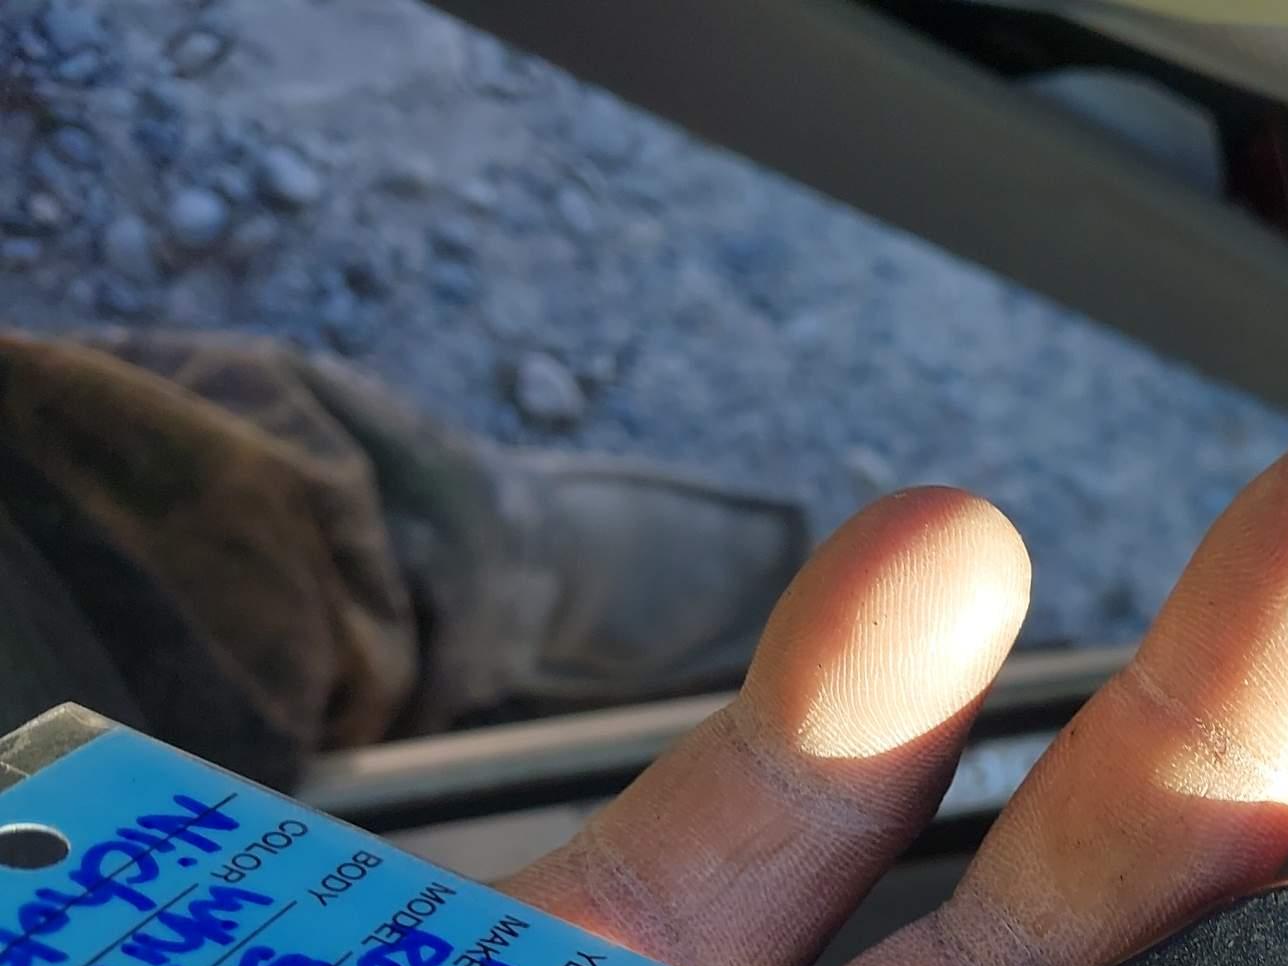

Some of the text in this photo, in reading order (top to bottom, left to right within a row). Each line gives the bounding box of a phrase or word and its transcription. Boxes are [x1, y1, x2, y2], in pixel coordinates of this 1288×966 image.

[210, 820, 308, 883] COLOR
[308, 851, 383, 906] BODY
[361, 882, 456, 946] MODEL
